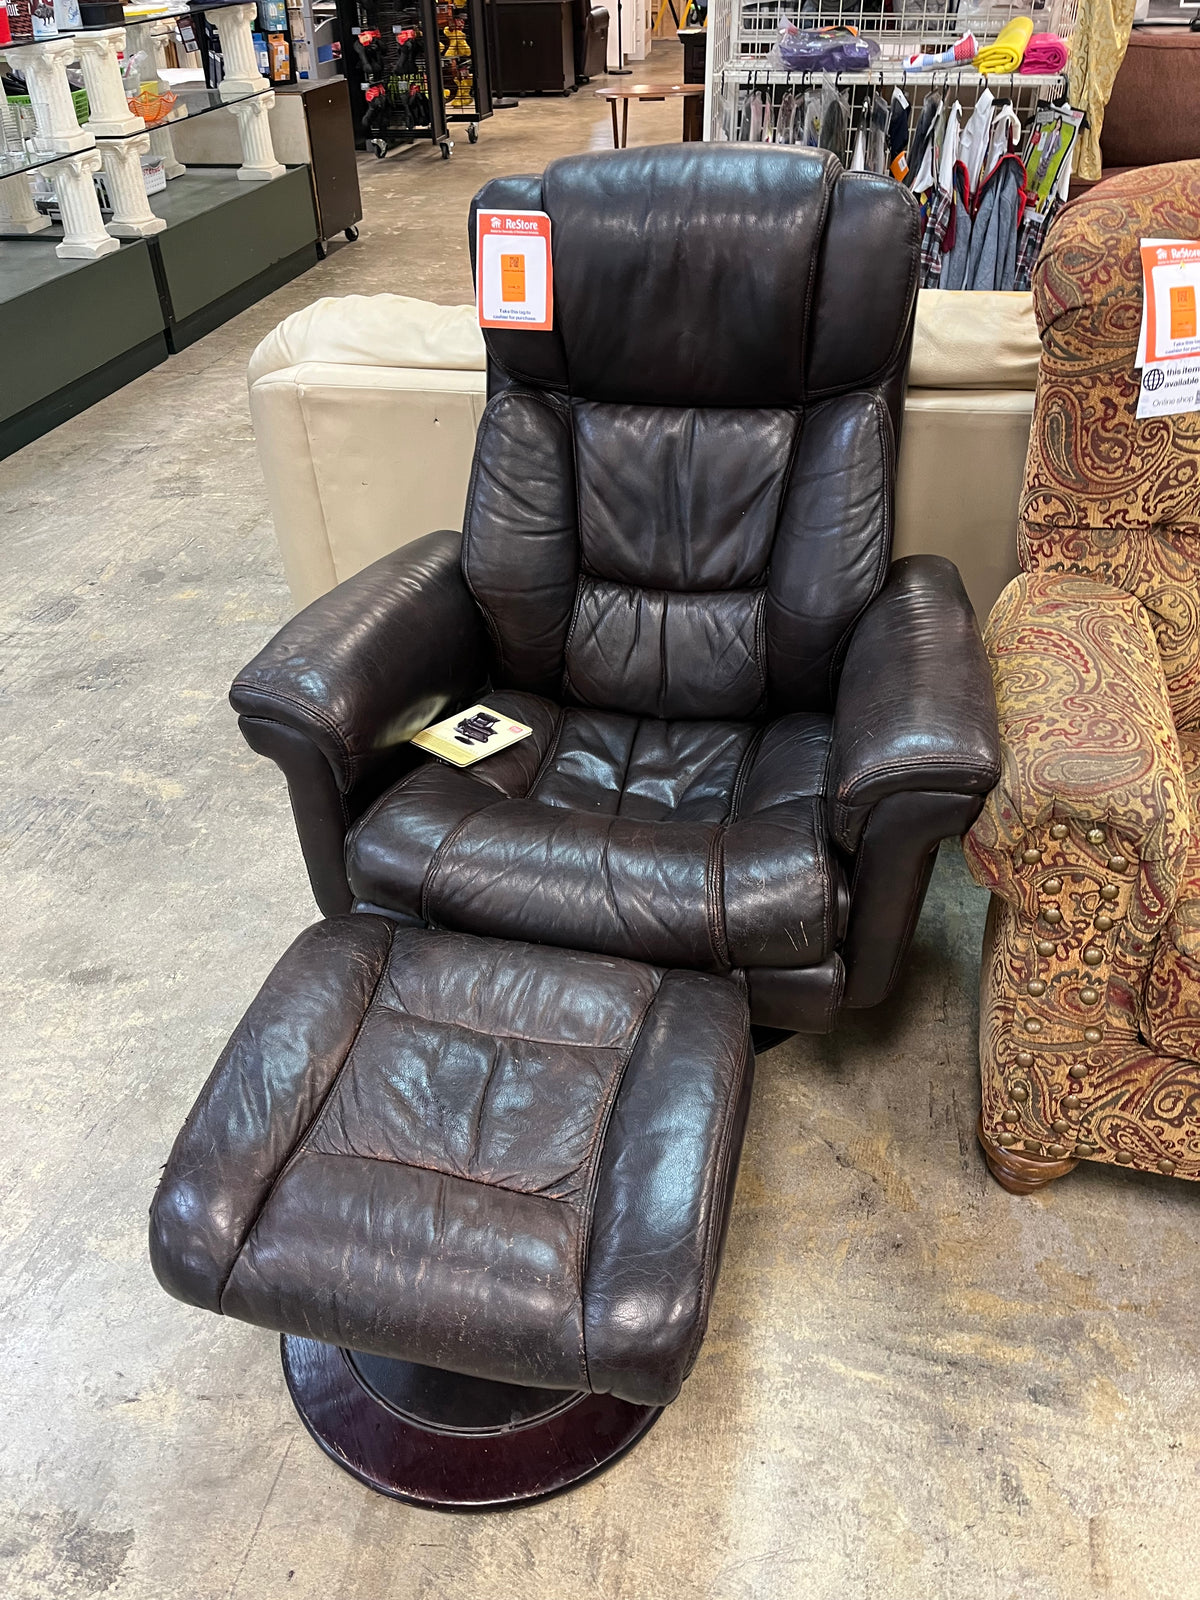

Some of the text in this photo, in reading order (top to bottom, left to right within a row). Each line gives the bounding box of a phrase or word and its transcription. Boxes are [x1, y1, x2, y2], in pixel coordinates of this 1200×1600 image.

[505, 218, 538, 230] ReStore
[1167, 367, 1181, 376] this
[1164, 377, 1199, 388] available
[1152, 396, 1193, 407] Online shop
